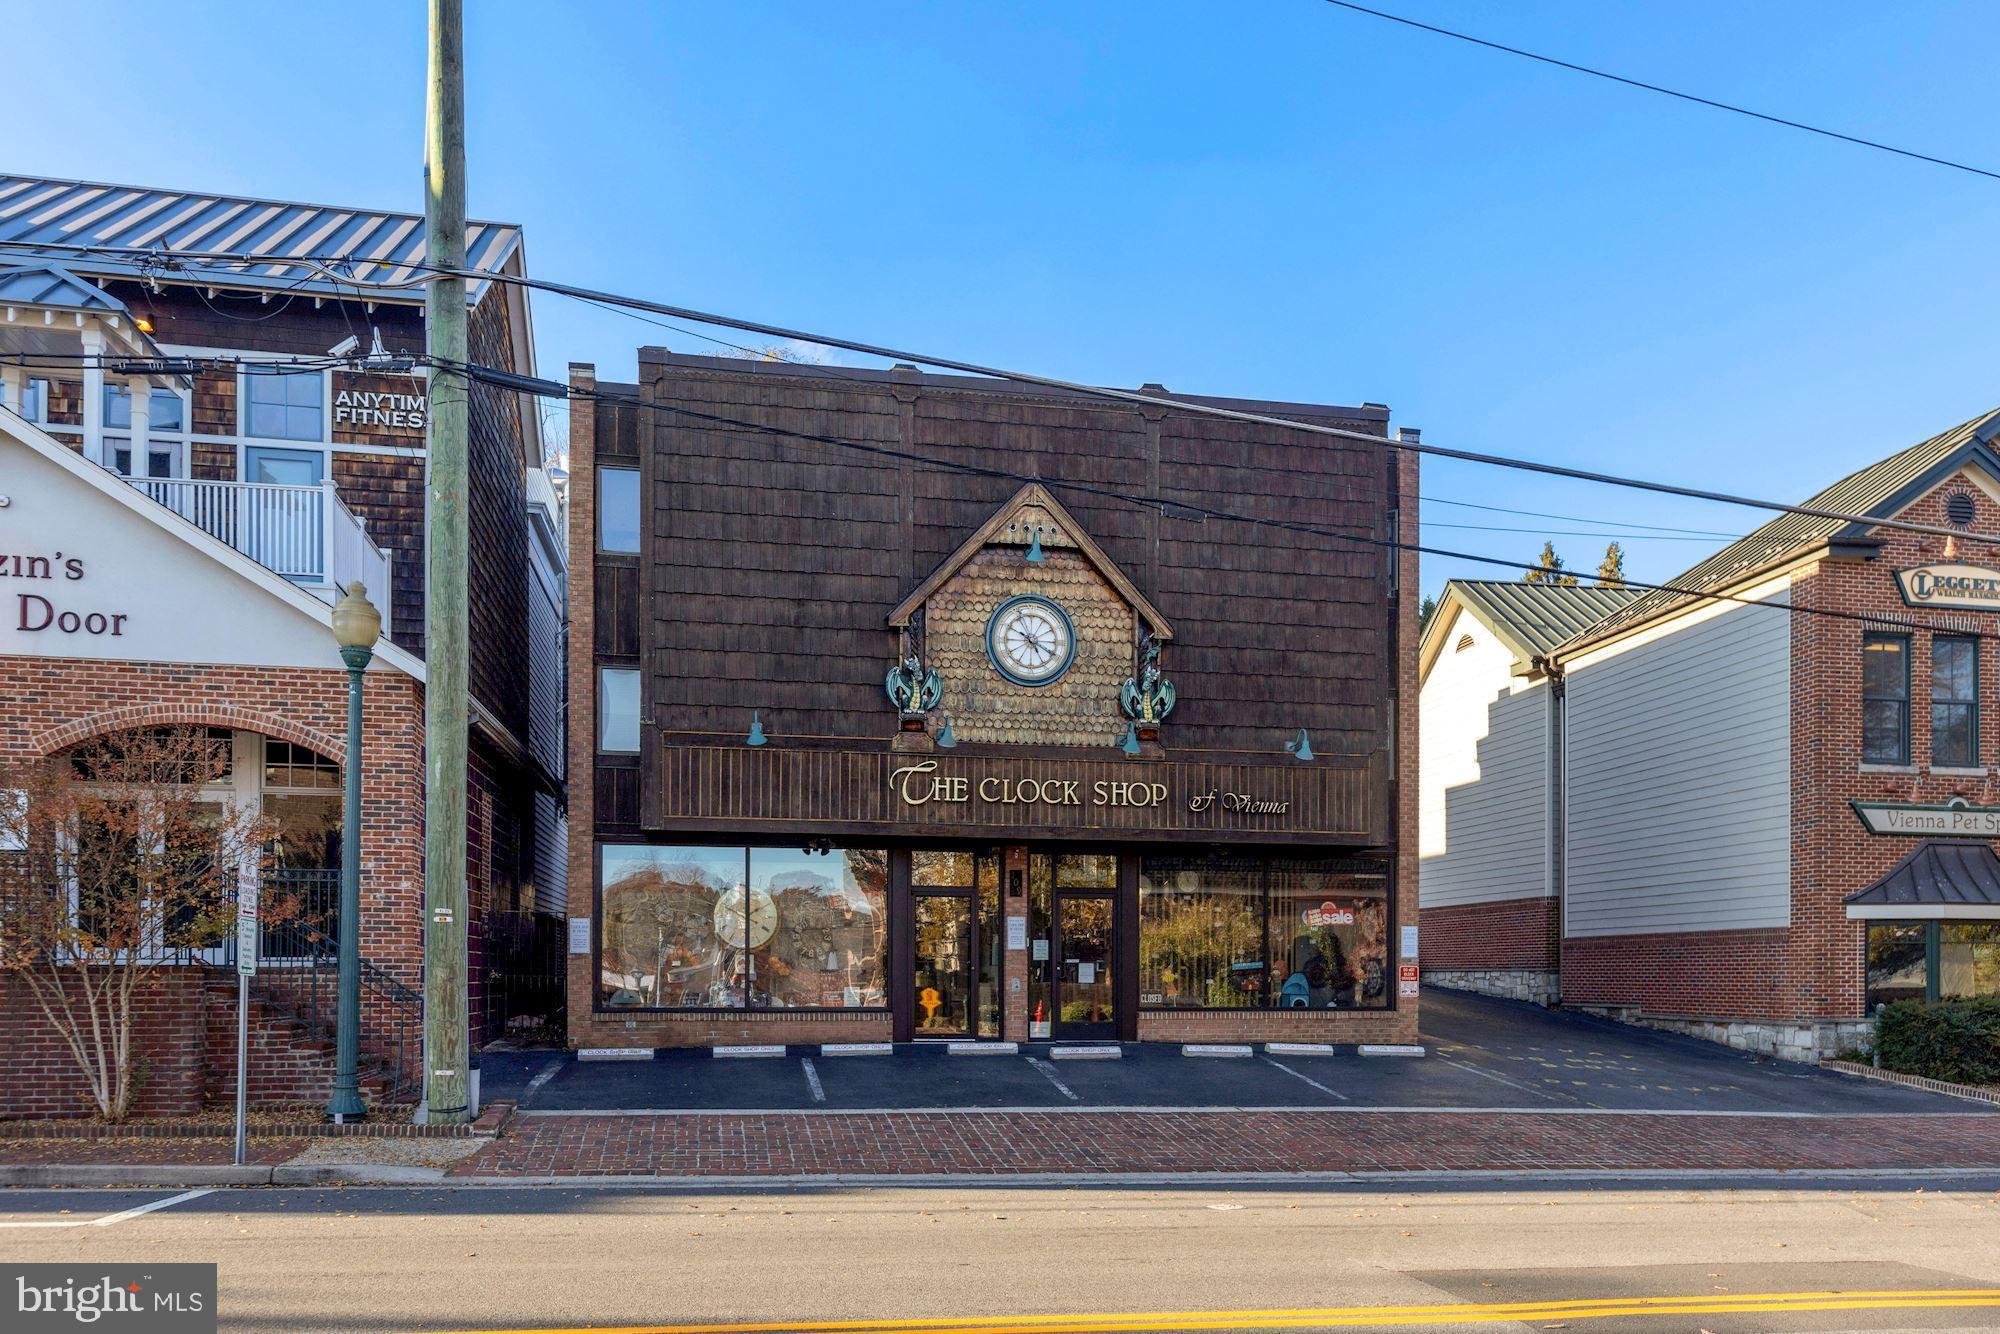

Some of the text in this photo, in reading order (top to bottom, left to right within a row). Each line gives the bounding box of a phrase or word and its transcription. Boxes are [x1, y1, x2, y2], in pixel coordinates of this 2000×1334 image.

[335, 390, 426, 411] ANYTIM
[336, 407, 426, 428] FITNES
[1917, 575, 2000, 596] LEGGET
[17, 593, 127, 636] Door
[979, 777, 1081, 805] CLOCK
[1093, 780, 1168, 807] SHOP
[1189, 788, 1218, 812] of
[1222, 792, 1289, 814] Vienna
[1887, 810, 1945, 829] Vienna
[1952, 813, 1978, 830] Pet
[1322, 909, 1354, 925] sale
[1141, 994, 1162, 1003] CLOSED
